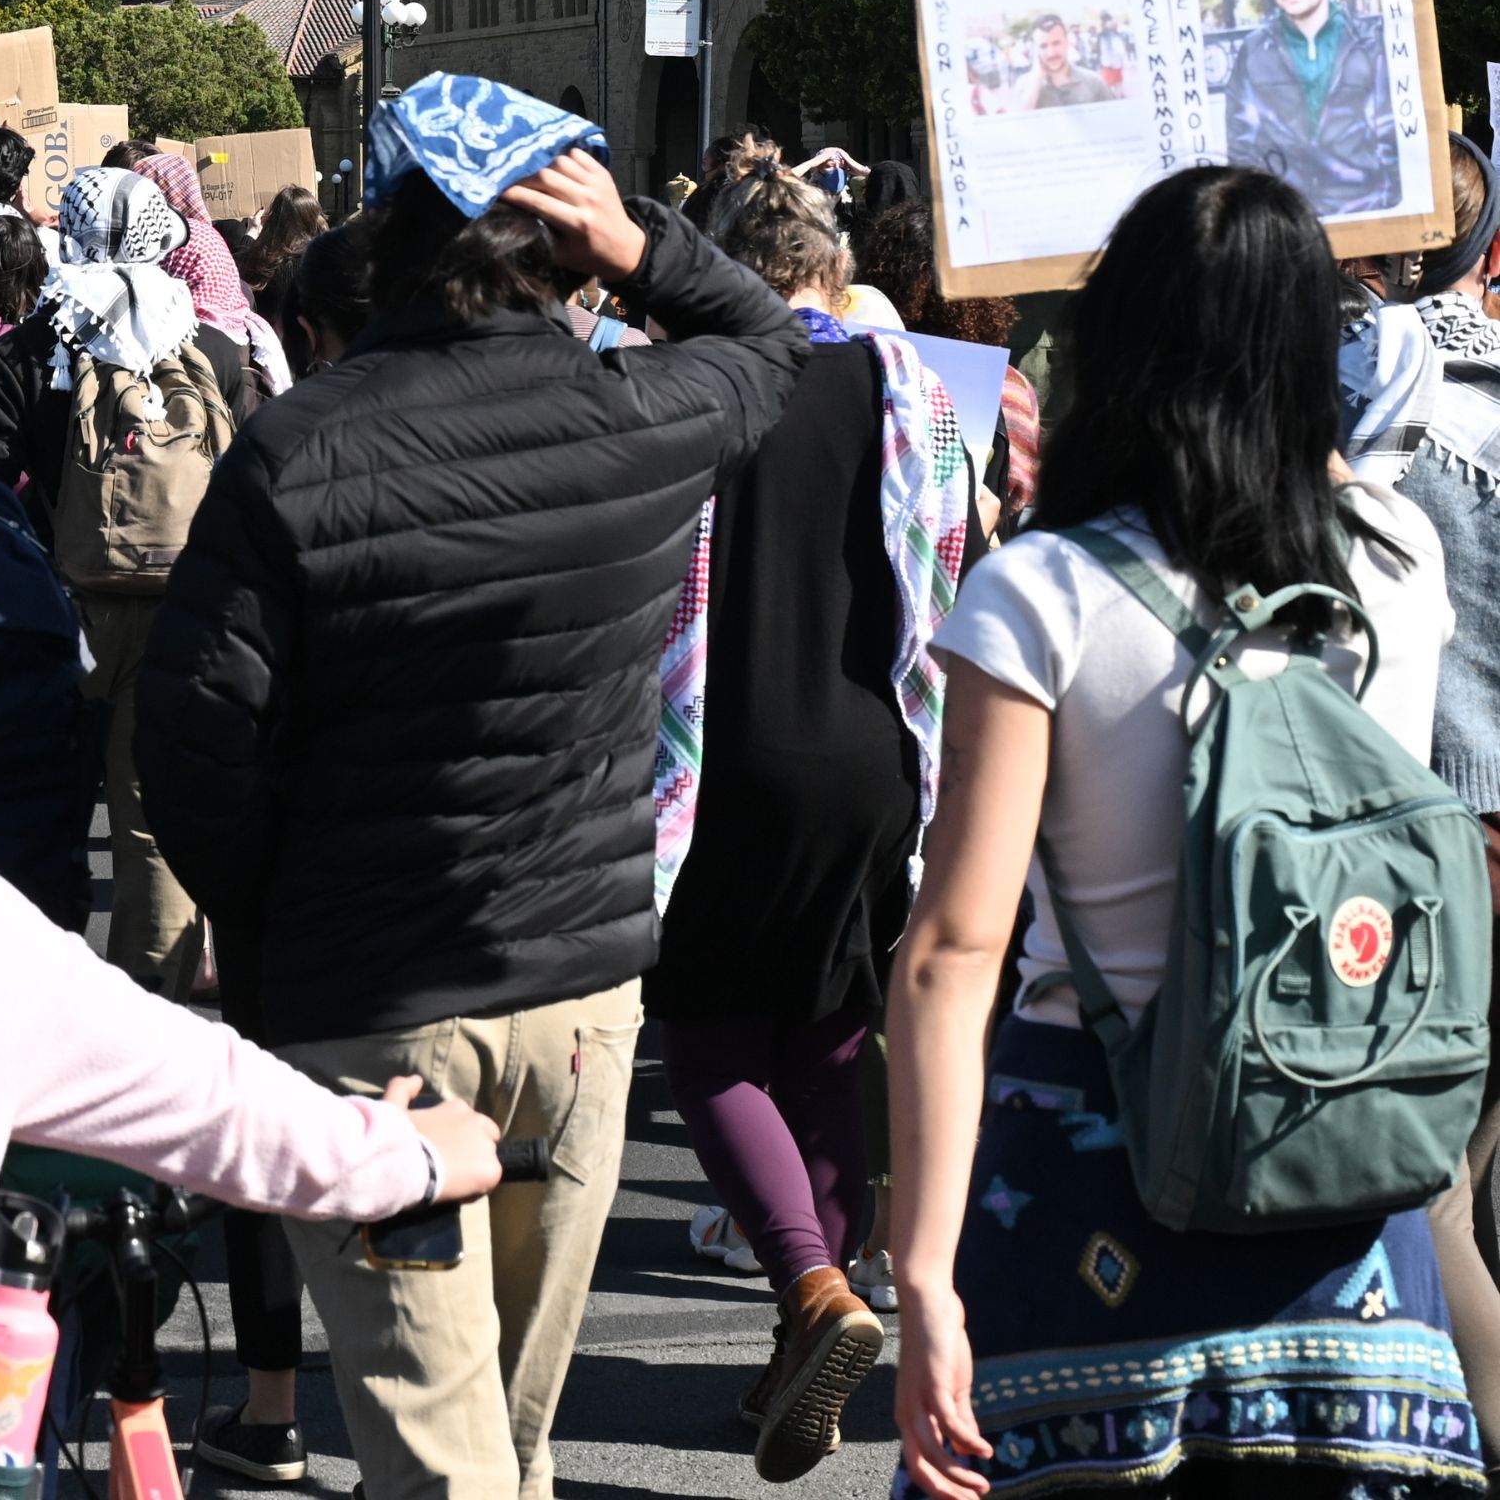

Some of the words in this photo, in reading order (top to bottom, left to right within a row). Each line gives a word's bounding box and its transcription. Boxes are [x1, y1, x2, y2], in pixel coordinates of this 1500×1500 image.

[936, 42, 952, 72] ON
[1389, 1, 1409, 59] HIM
[1148, 53, 1176, 170] MAHMOUD
[1397, 75, 1418, 138] NOW
[941, 88, 971, 232] COLUMBIA
